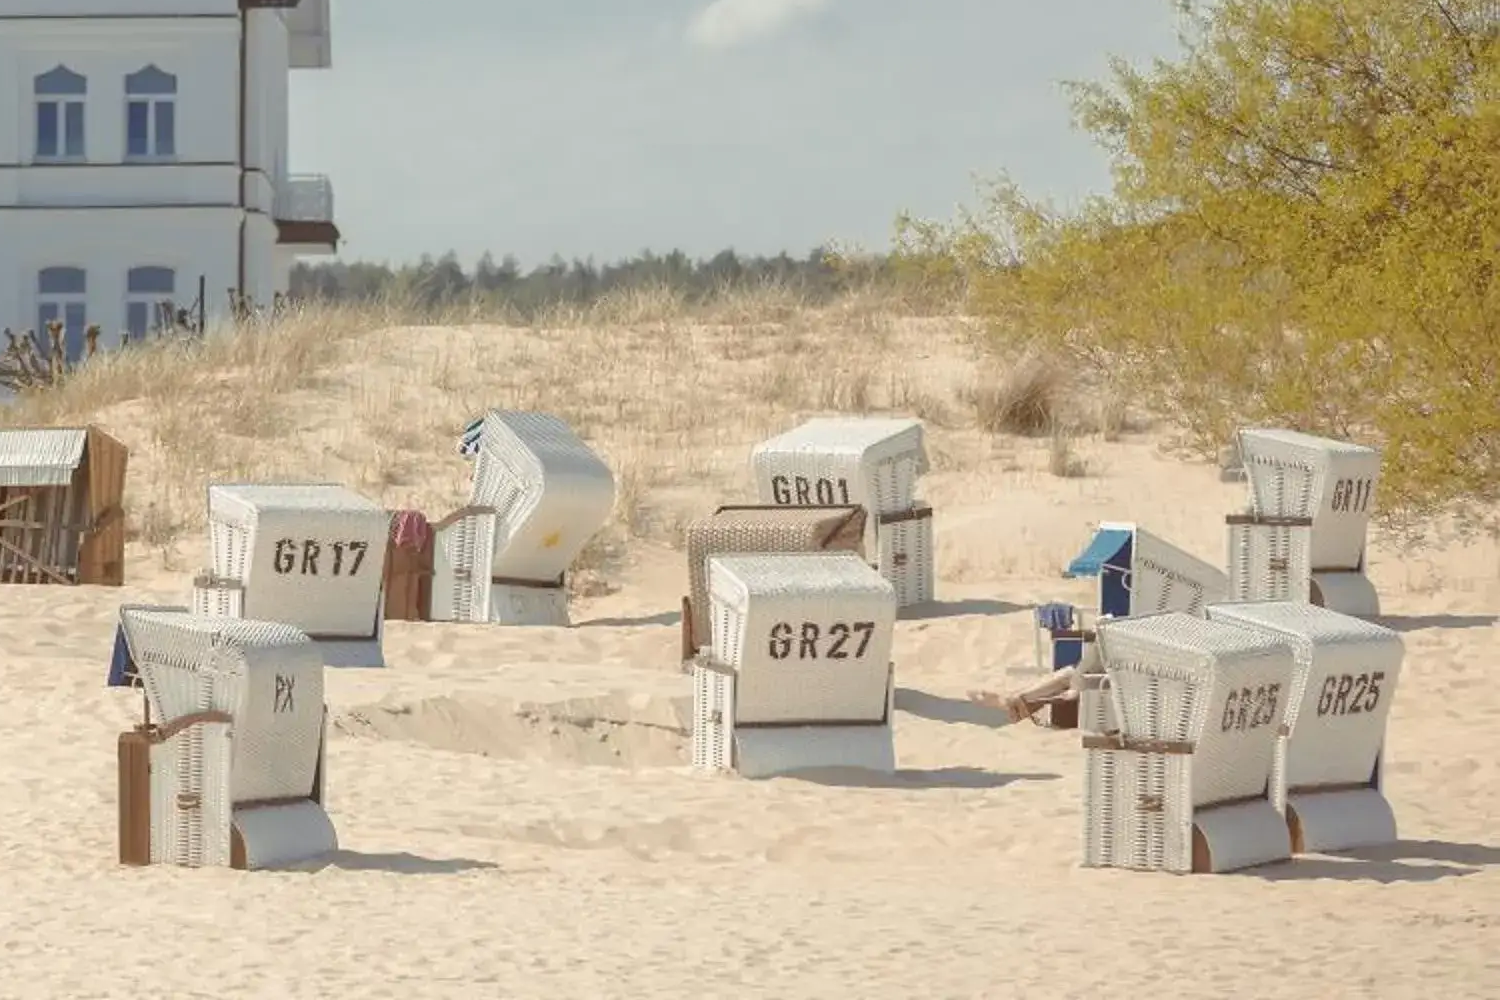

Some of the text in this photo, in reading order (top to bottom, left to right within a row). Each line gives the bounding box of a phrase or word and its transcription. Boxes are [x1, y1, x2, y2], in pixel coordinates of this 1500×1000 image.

[772, 475, 849, 504] GR01
[1331, 479, 1371, 512] GR11
[769, 622, 875, 659] GR27
[273, 673, 295, 713] PX
[1221, 682, 1281, 732] GR25
[1316, 671, 1385, 717] GR25
